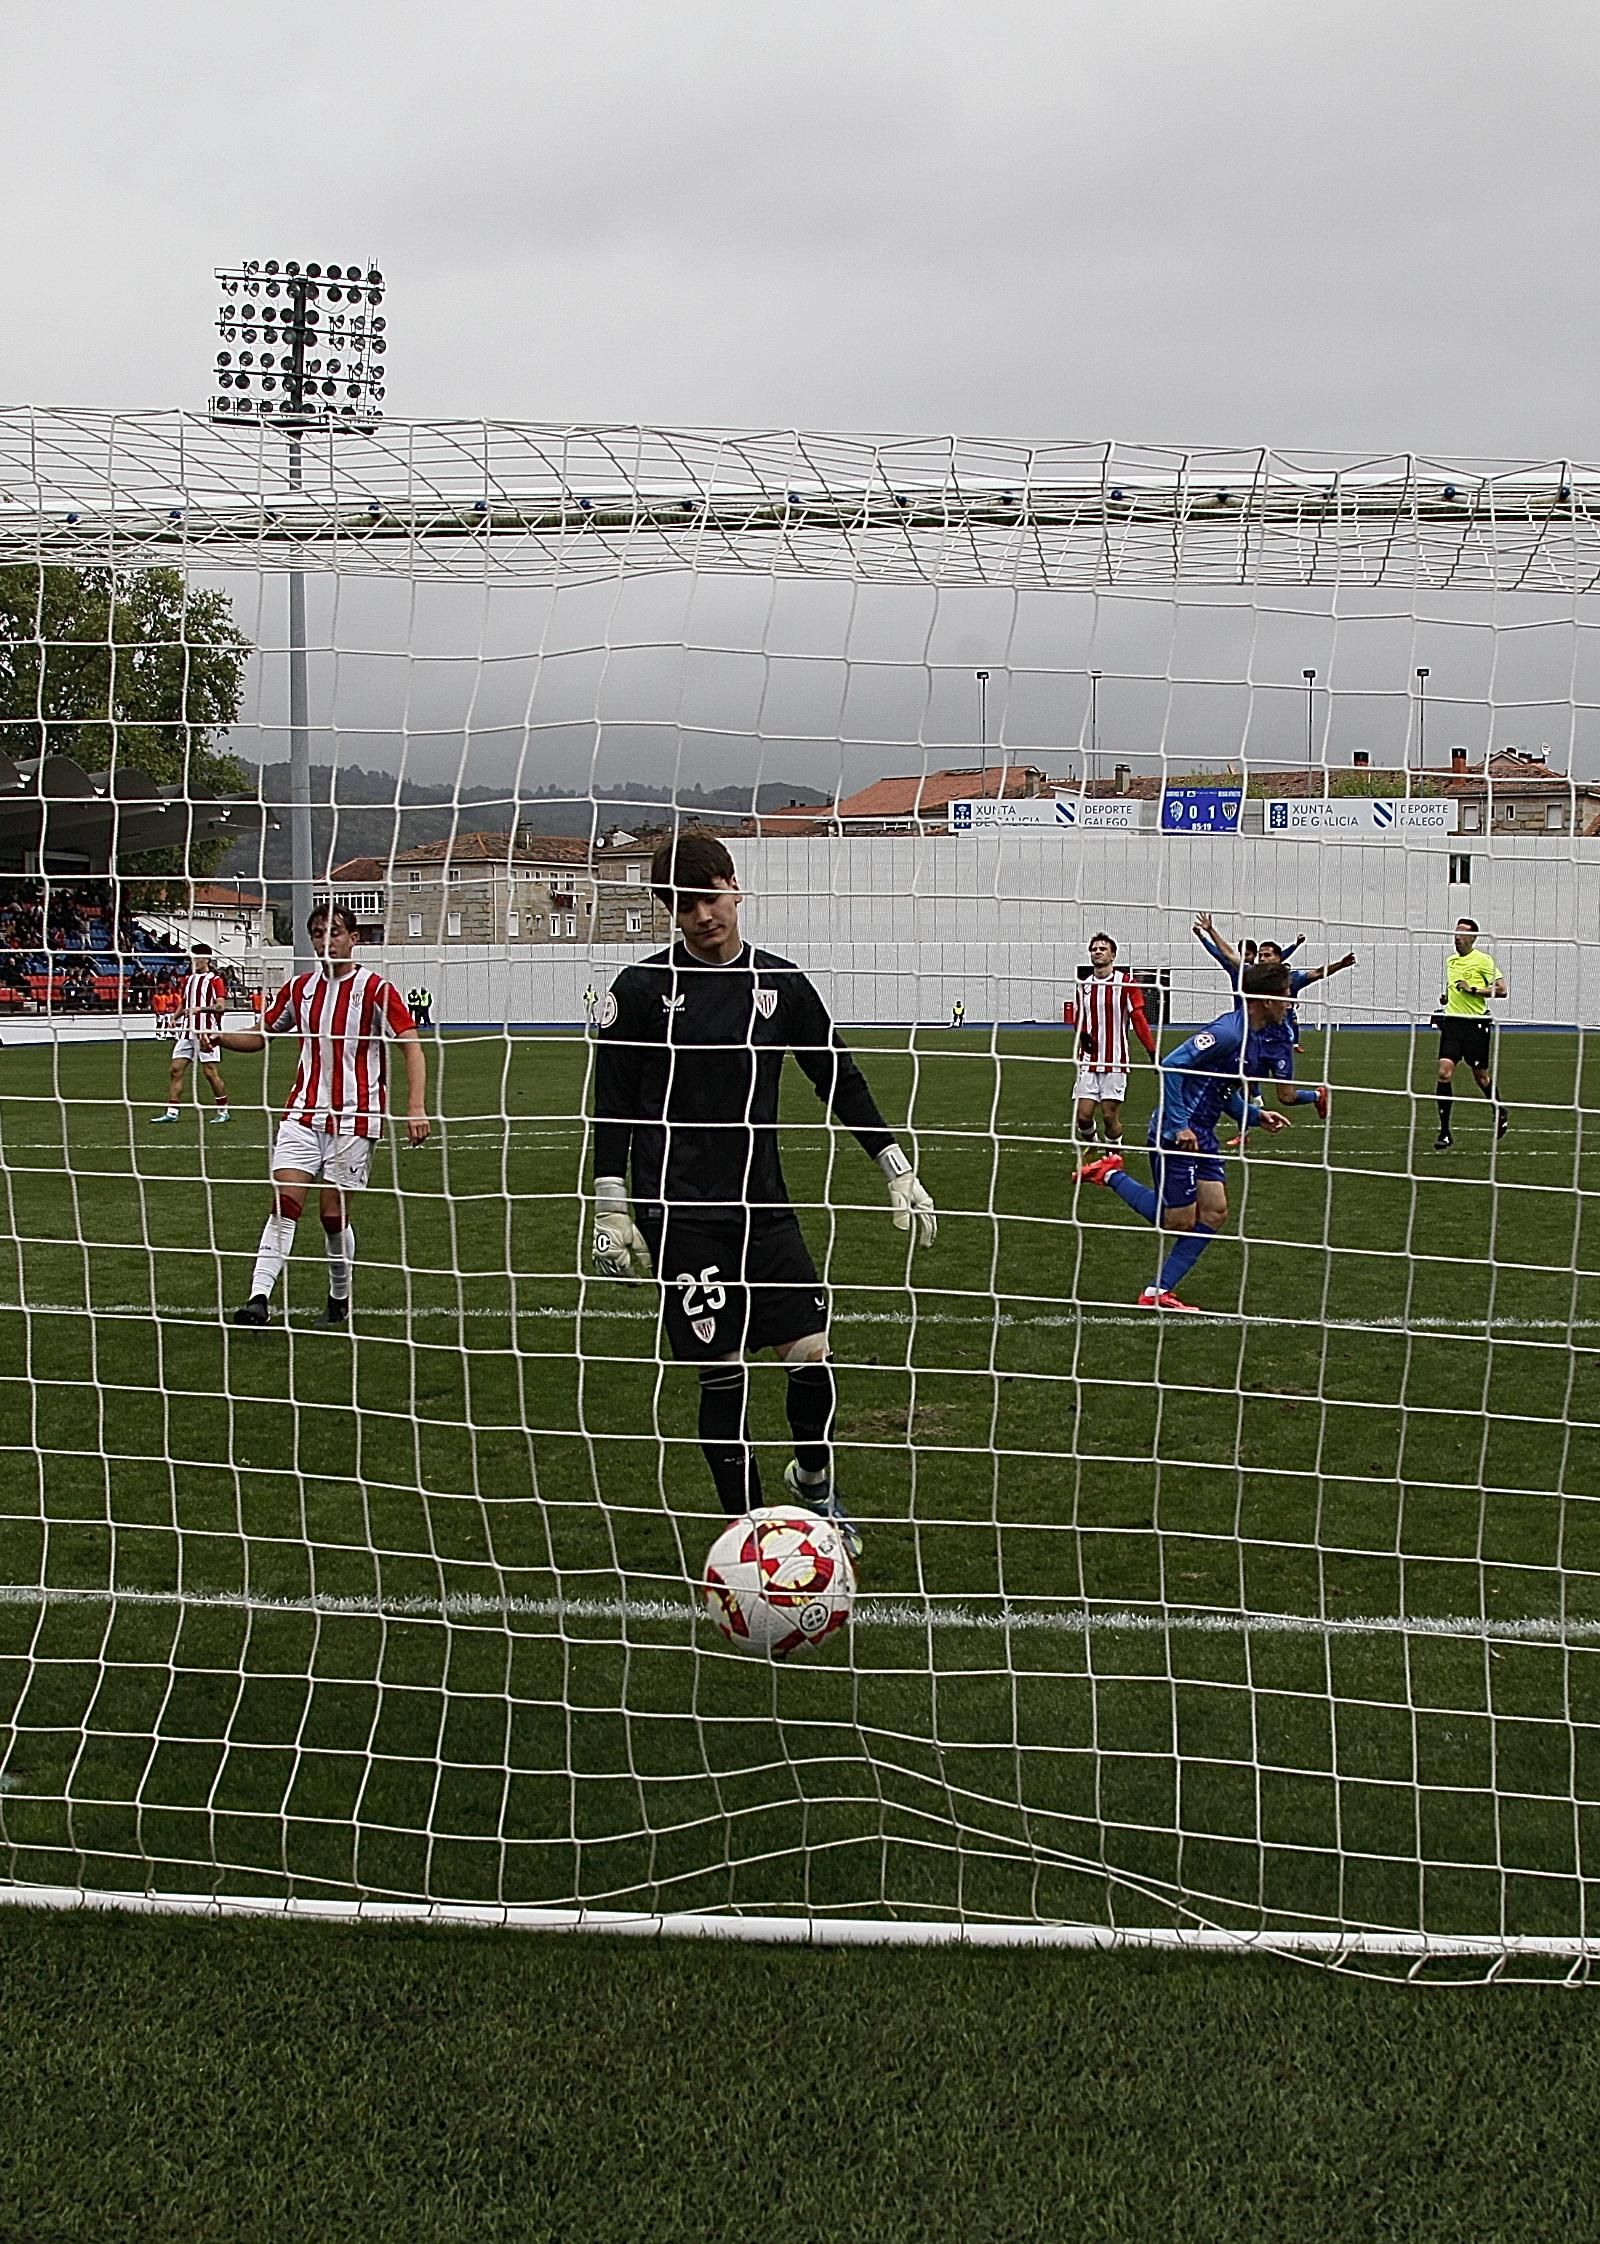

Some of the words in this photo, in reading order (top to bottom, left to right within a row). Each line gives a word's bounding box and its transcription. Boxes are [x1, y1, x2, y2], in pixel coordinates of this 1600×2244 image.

[1084, 805, 1133, 815] DEPORTE
[1189, 805, 1198, 819] 0
[1208, 805, 1215, 819] 1
[1292, 804, 1333, 814] XUNTA
[1292, 816, 1307, 827] DE
[676, 1265, 726, 1316] 25
